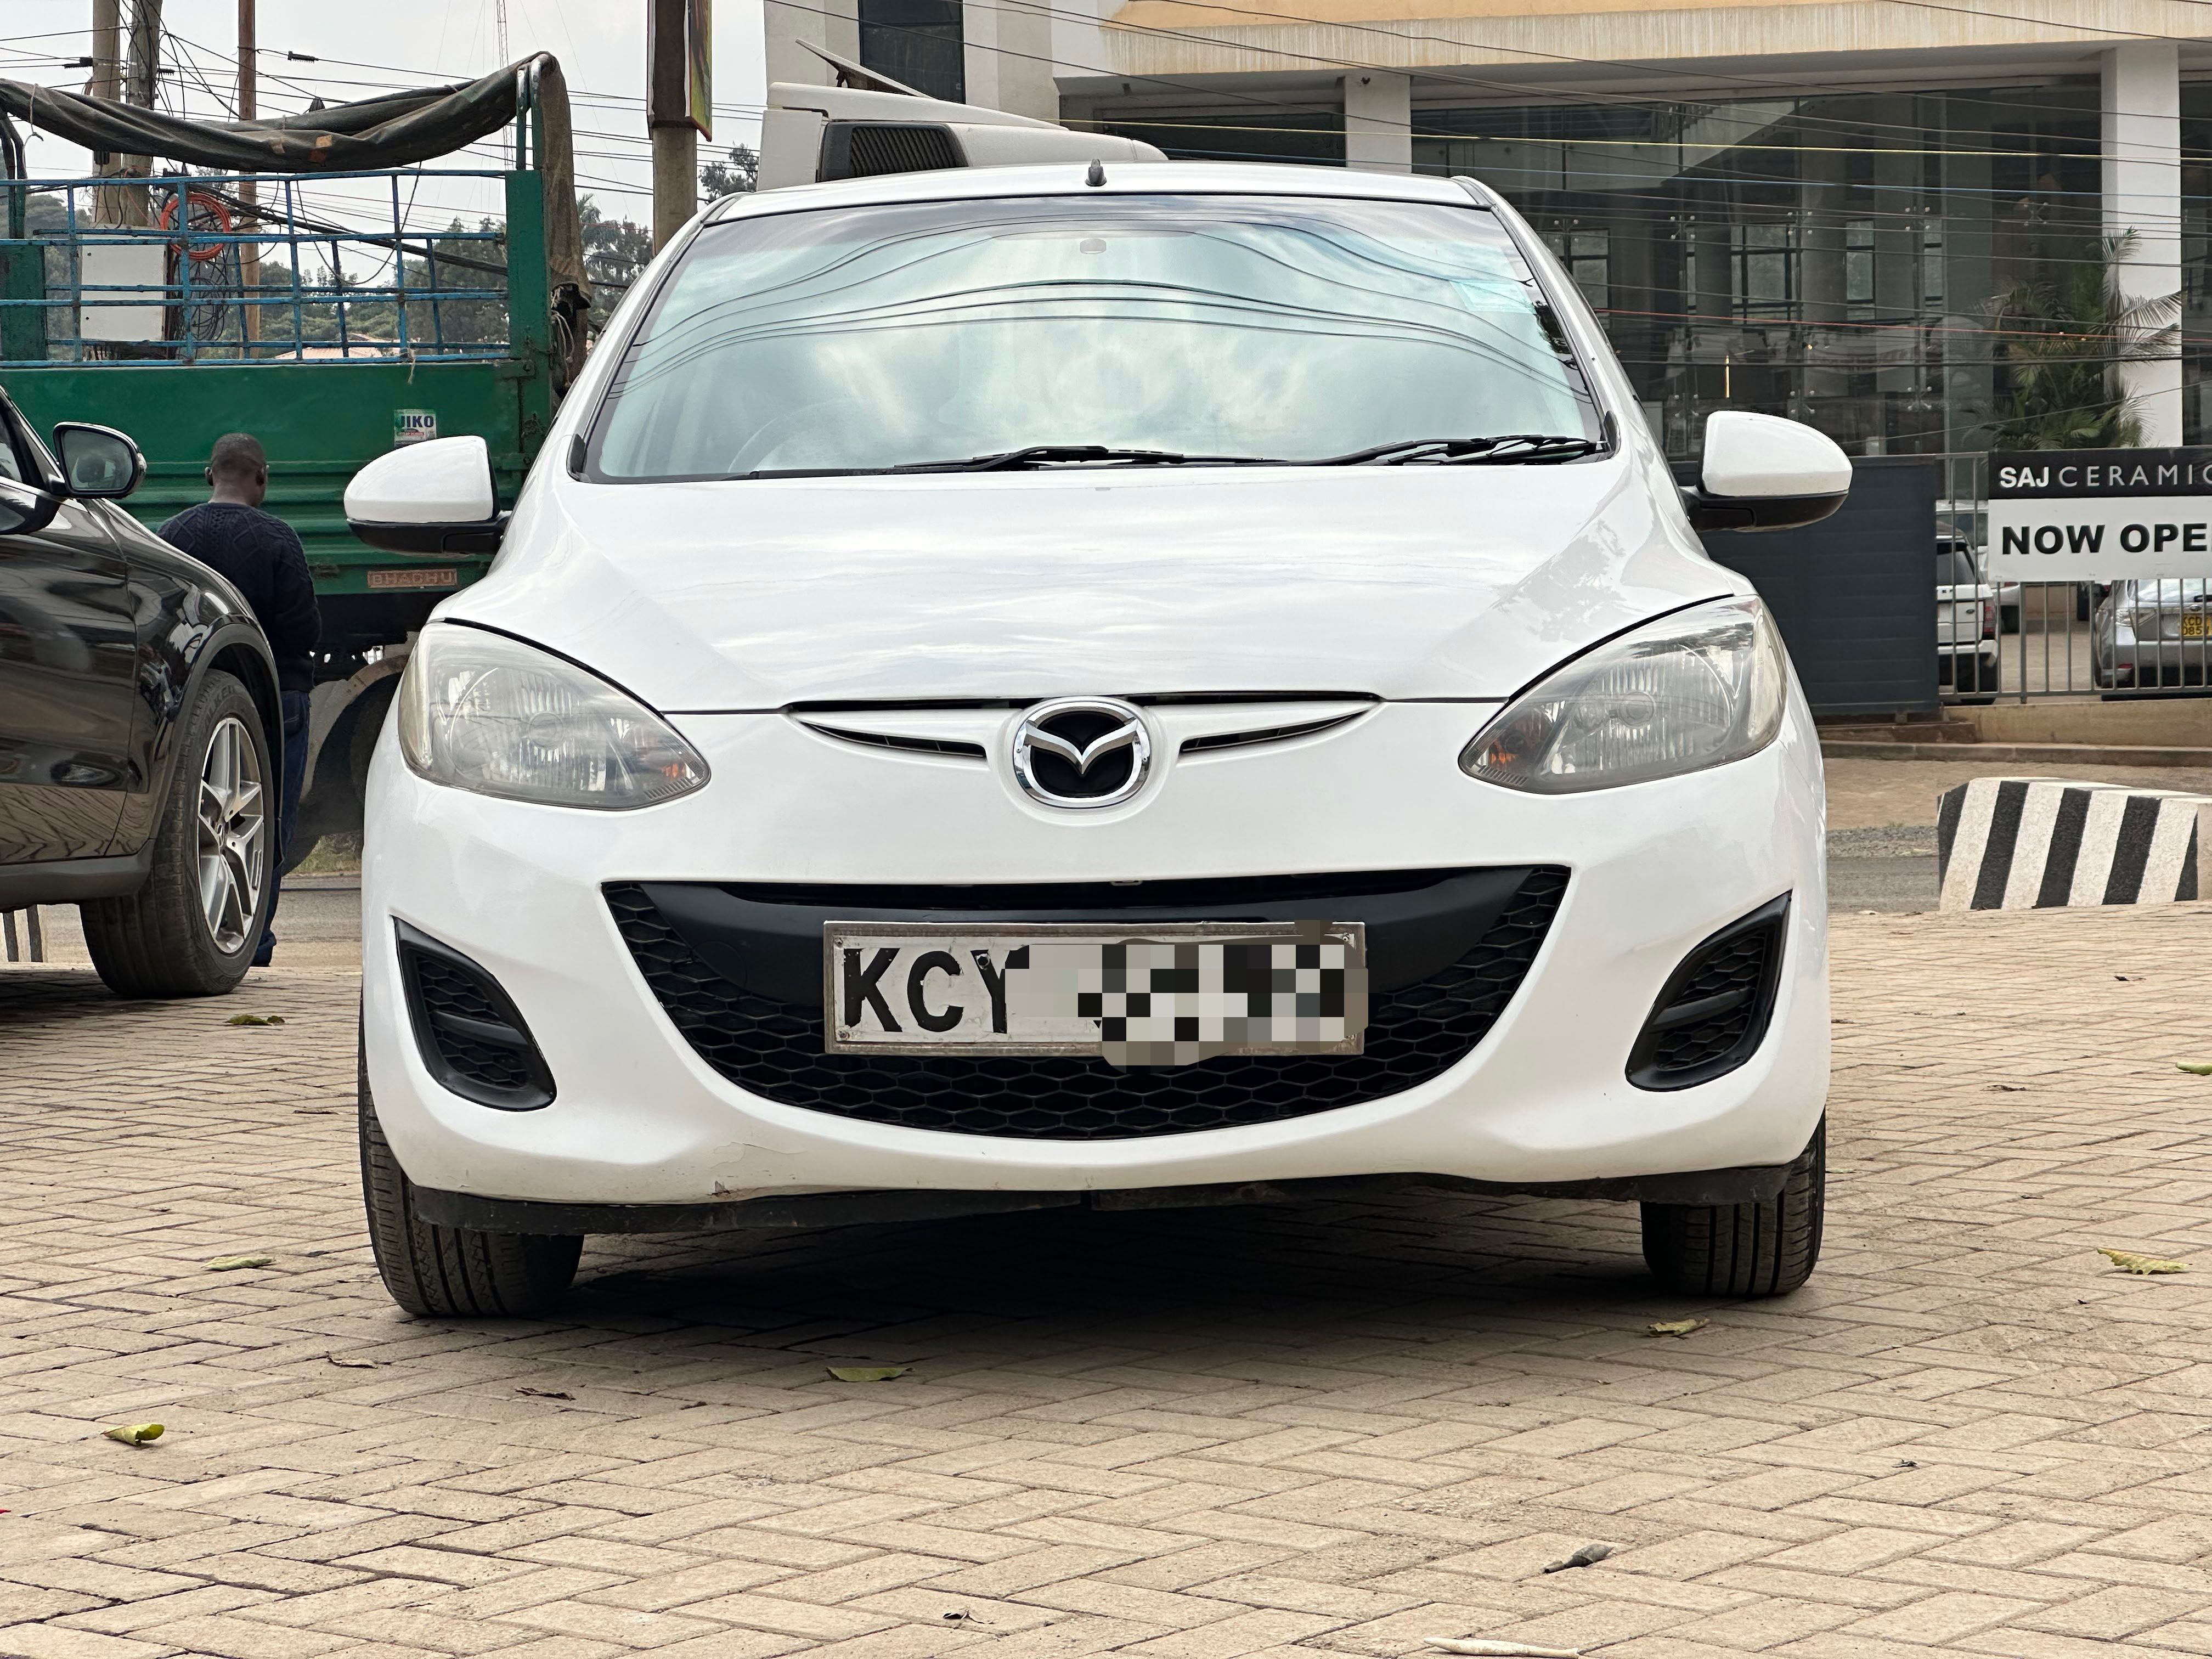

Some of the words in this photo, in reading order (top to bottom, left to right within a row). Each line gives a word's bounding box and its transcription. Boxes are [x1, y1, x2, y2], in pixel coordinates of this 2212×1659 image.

[398, 415, 434, 428] JIKO
[2000, 466, 2049, 488] SAJ
[2002, 524, 2106, 555] NOW
[2120, 523, 2212, 553] OPE
[843, 947, 1014, 1034] KCY
